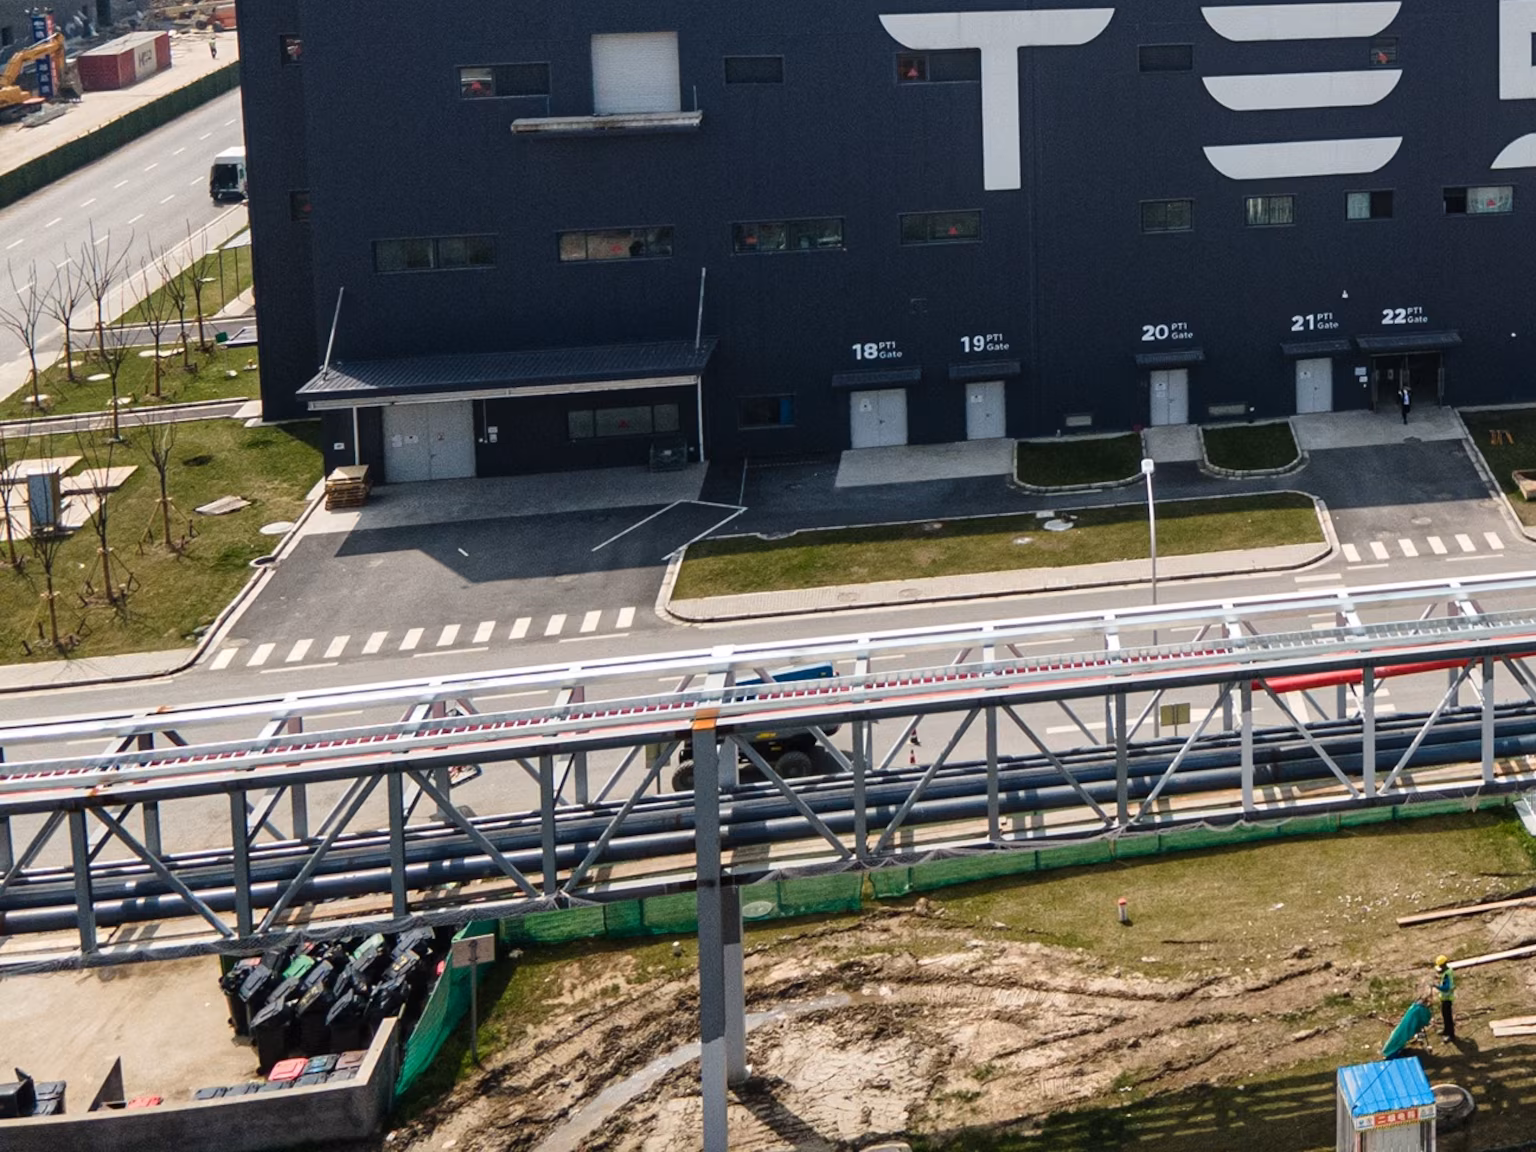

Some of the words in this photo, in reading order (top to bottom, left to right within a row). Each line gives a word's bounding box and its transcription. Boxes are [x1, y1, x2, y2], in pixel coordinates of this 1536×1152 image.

[1407, 306, 1423, 315] PT1
[1317, 312, 1333, 321] PT1
[1381, 307, 1407, 325] 22
[1407, 316, 1428, 324] Gate
[1171, 322, 1188, 331] PT1
[1290, 314, 1315, 332] 21
[1317, 322, 1339, 330] Gate
[986, 333, 1003, 342] PT1
[1141, 324, 1169, 342] 20
[1171, 332, 1194, 340] Gate
[878, 341, 896, 349] PT1
[960, 335, 985, 353] 19
[986, 343, 1010, 351] Gate
[851, 342, 879, 360] 18
[878, 351, 903, 359] Gate
